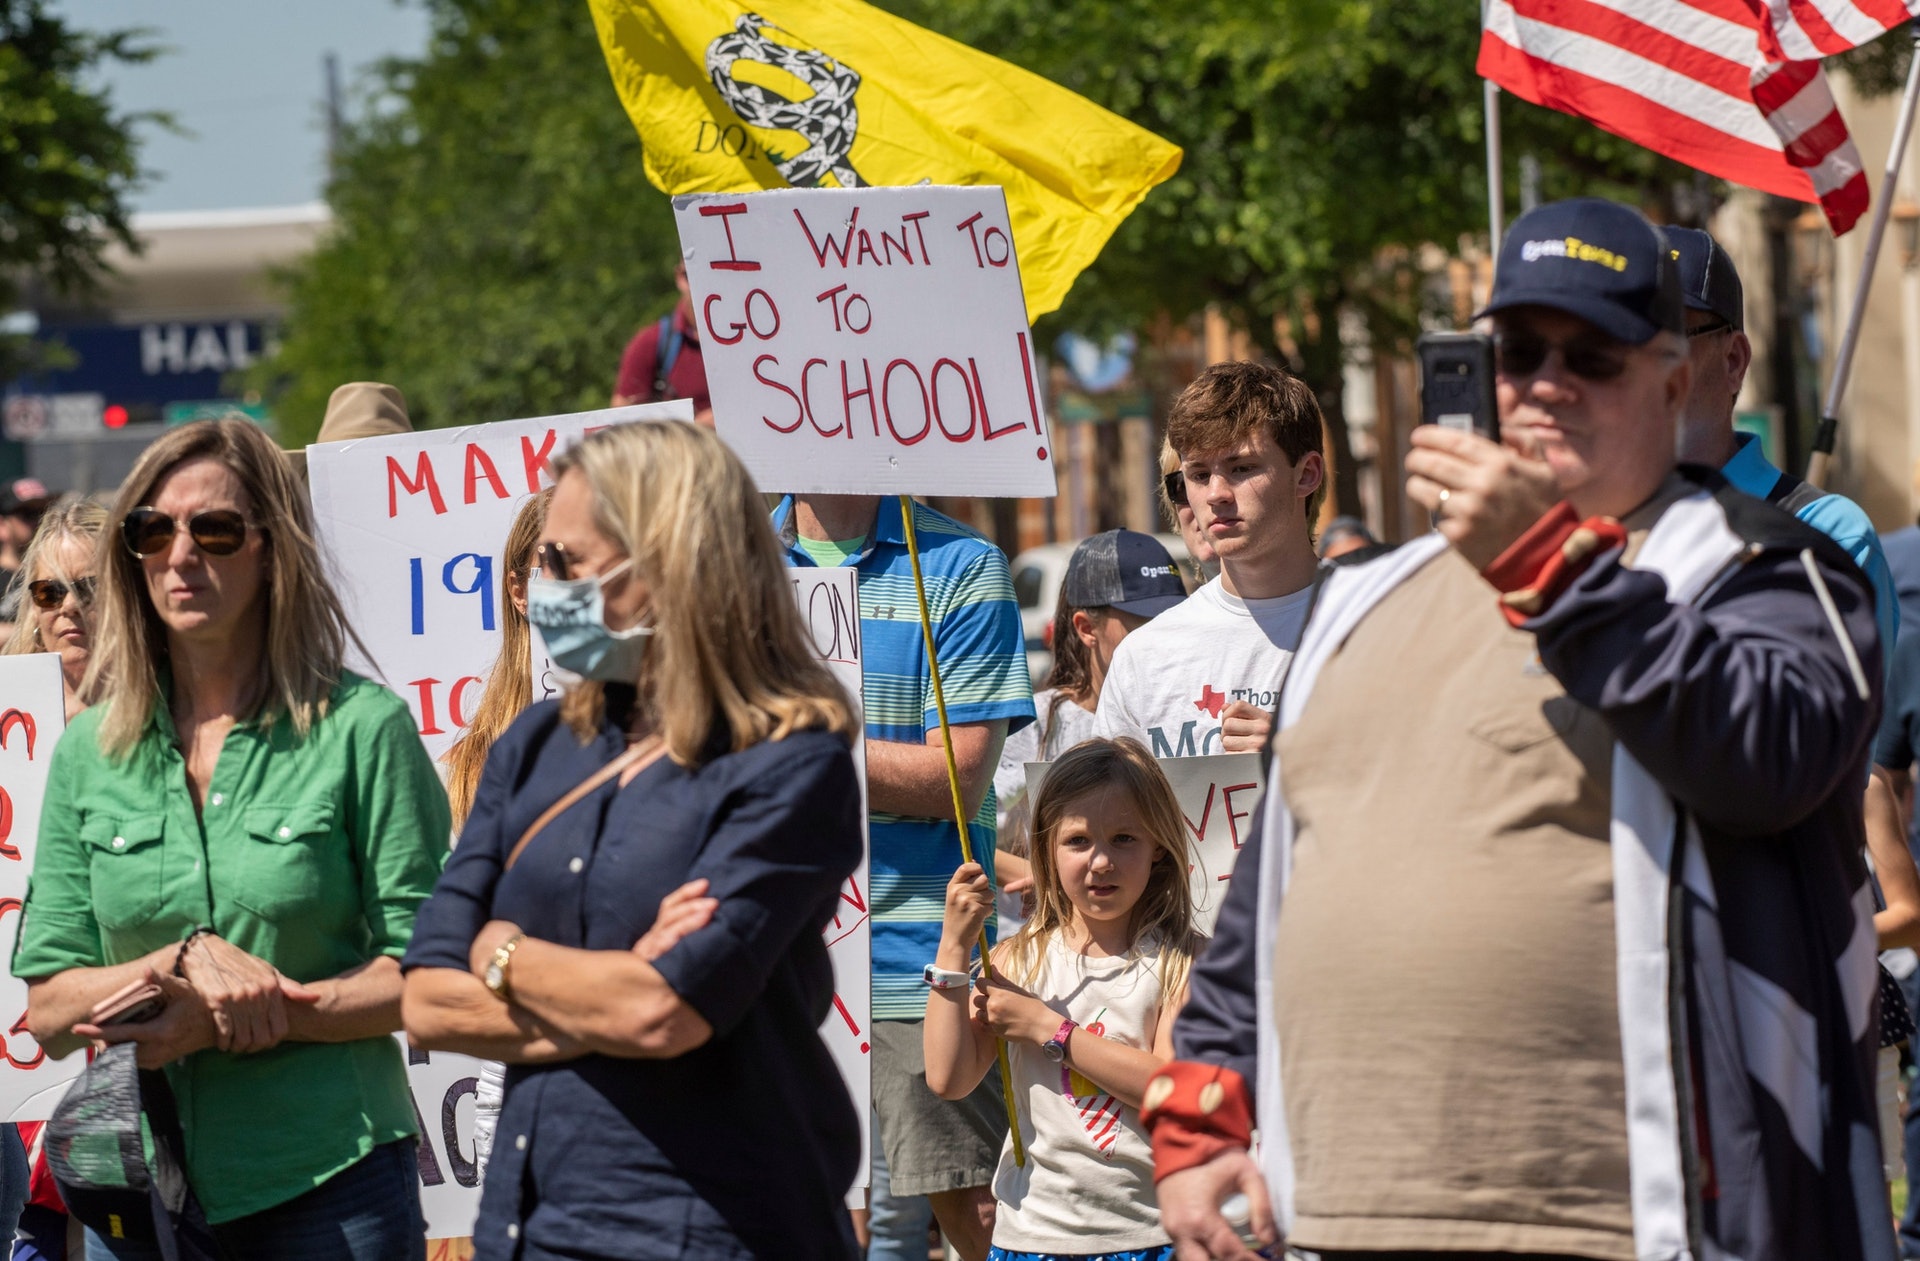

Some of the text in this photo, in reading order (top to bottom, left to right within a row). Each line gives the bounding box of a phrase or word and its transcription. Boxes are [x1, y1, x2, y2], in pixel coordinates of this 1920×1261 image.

[699, 202, 1010, 272] I WANT TO
[139, 319, 260, 375] HAL
[703, 283, 872, 345] GO TO
[752, 331, 1048, 462] SCHOOL!
[386, 424, 612, 518] MAK
[409, 552, 496, 635] 19
